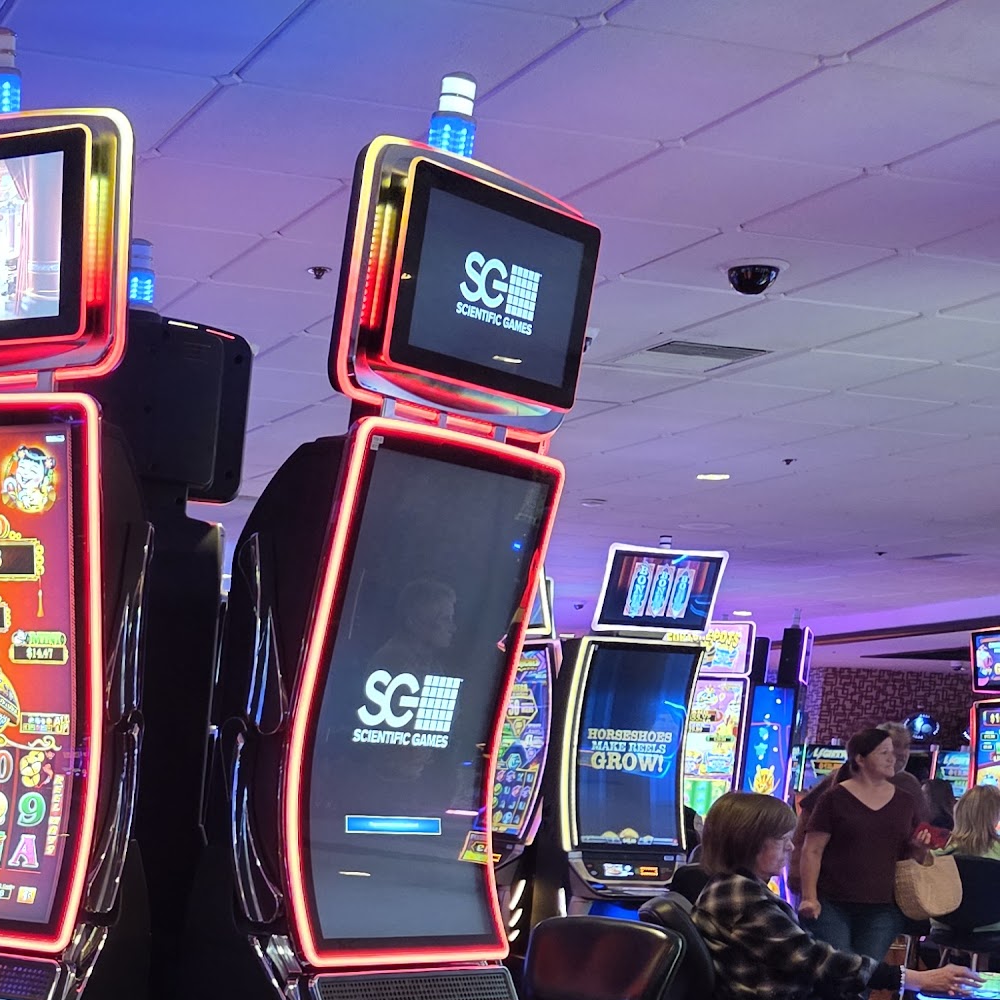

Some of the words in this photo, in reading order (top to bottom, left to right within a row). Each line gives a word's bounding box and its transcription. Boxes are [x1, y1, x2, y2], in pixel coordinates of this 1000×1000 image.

[459, 251, 509, 308] SG
[456, 301, 502, 326] SCIENTIFIC
[502, 316, 533, 336] GAMES
[357, 669, 420, 728] SG
[352, 728, 411, 746] SCIENTIFIC
[411, 733, 449, 748] GAMES
[587, 727, 673, 743] HORSESHOES
[591, 740, 626, 752] MAKE
[628, 742, 667, 755] REELS
[590, 751, 664, 773] GROW!
[17, 791, 46, 827] 9
[8, 834, 40, 868] A
